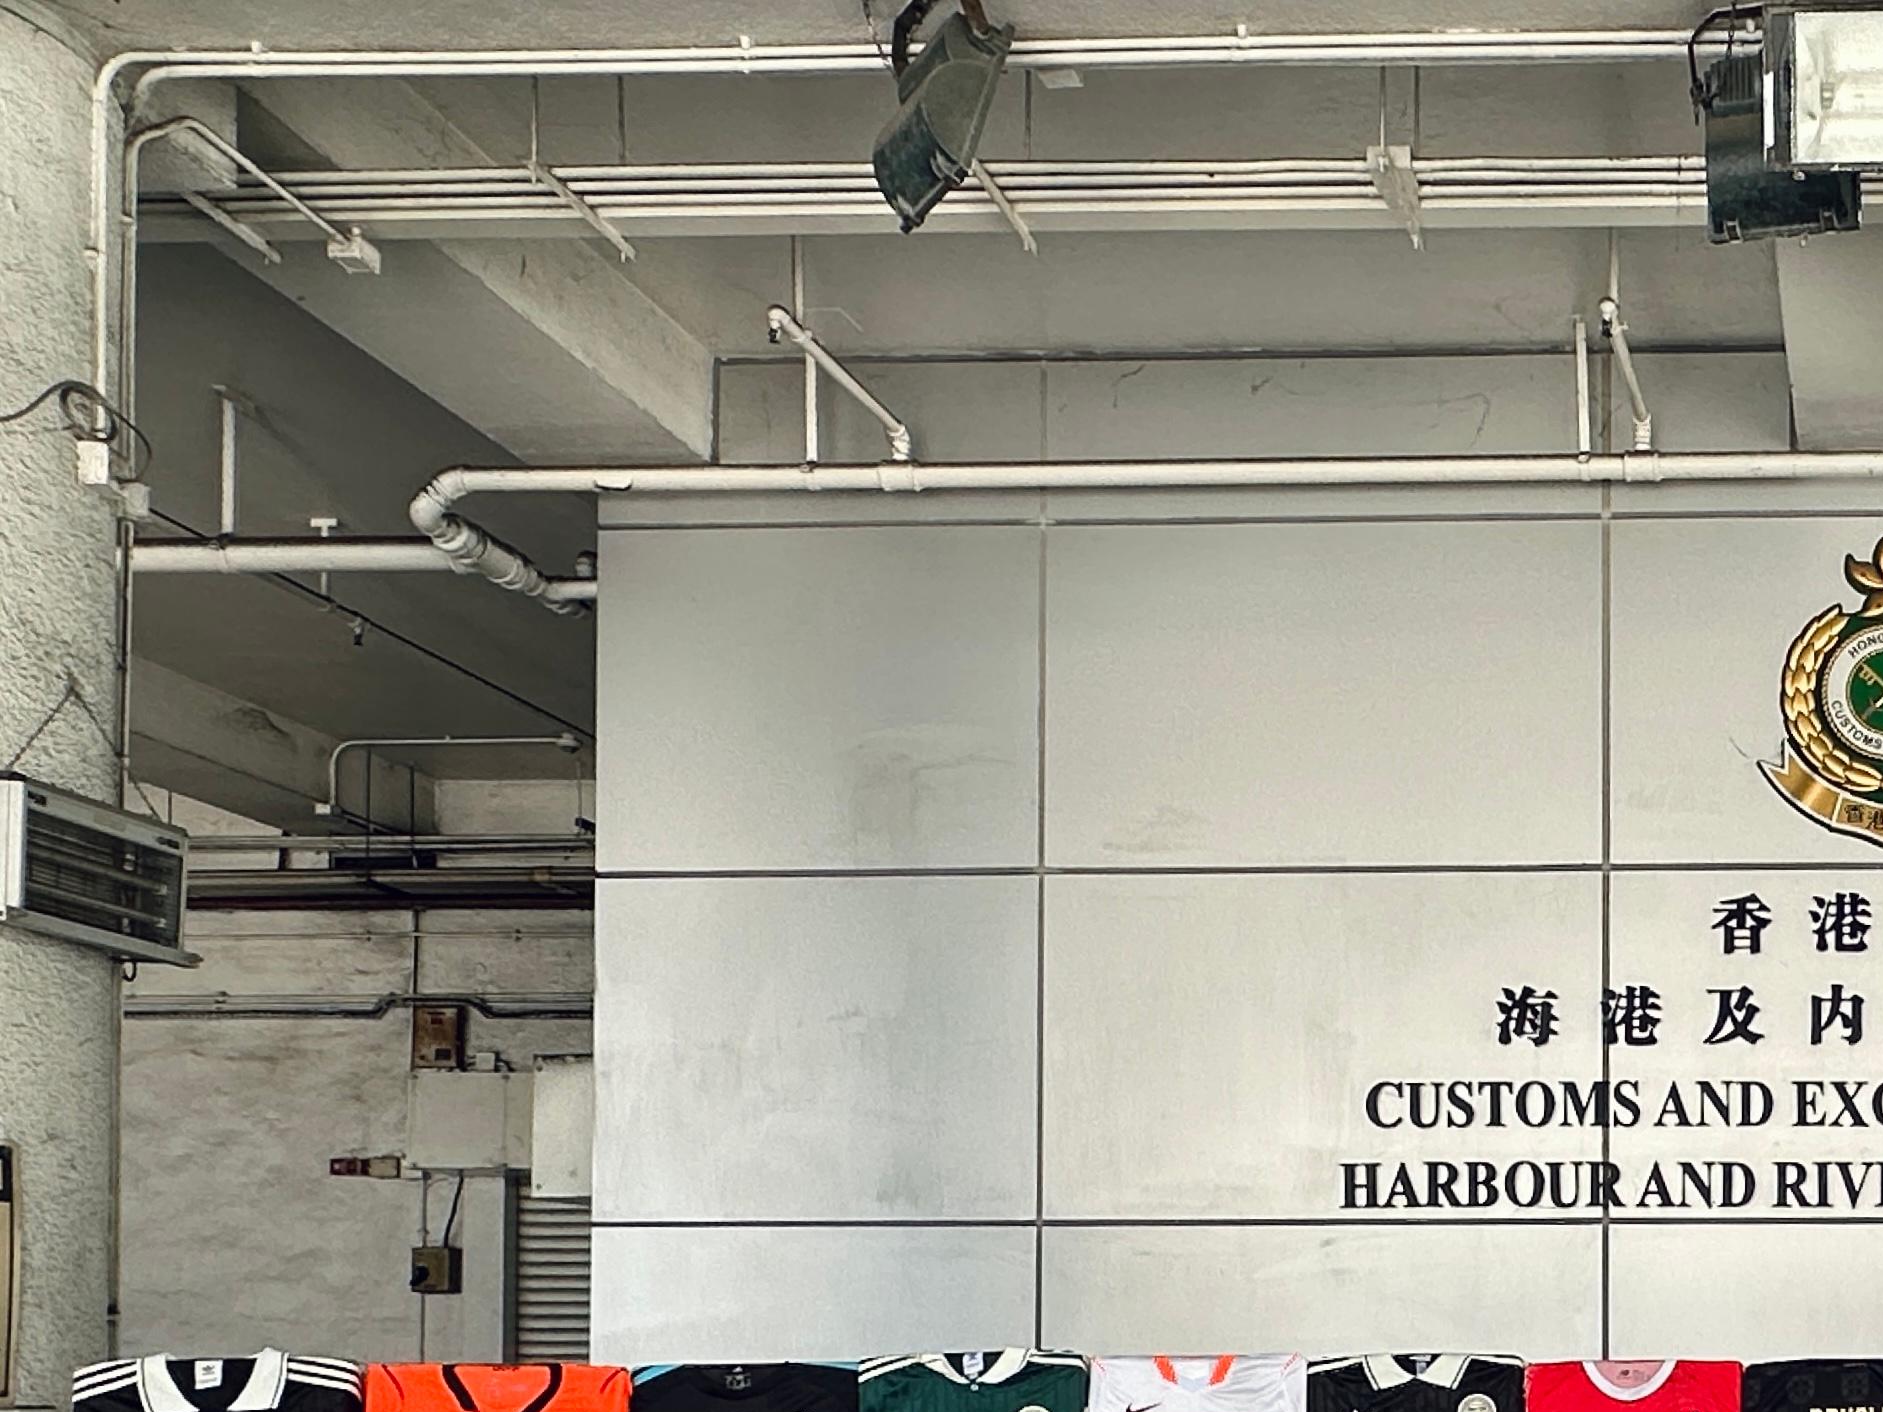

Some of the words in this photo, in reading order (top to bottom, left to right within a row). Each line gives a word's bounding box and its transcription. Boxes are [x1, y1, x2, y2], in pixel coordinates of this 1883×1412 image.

[1831, 700, 1883, 751] CUSTOMS
[1365, 1080, 1642, 1129] CUSTOMS
[1654, 1080, 1774, 1128] AND
[1339, 1161, 1628, 1209] HARBOUR
[1635, 1161, 1757, 1209] AND
